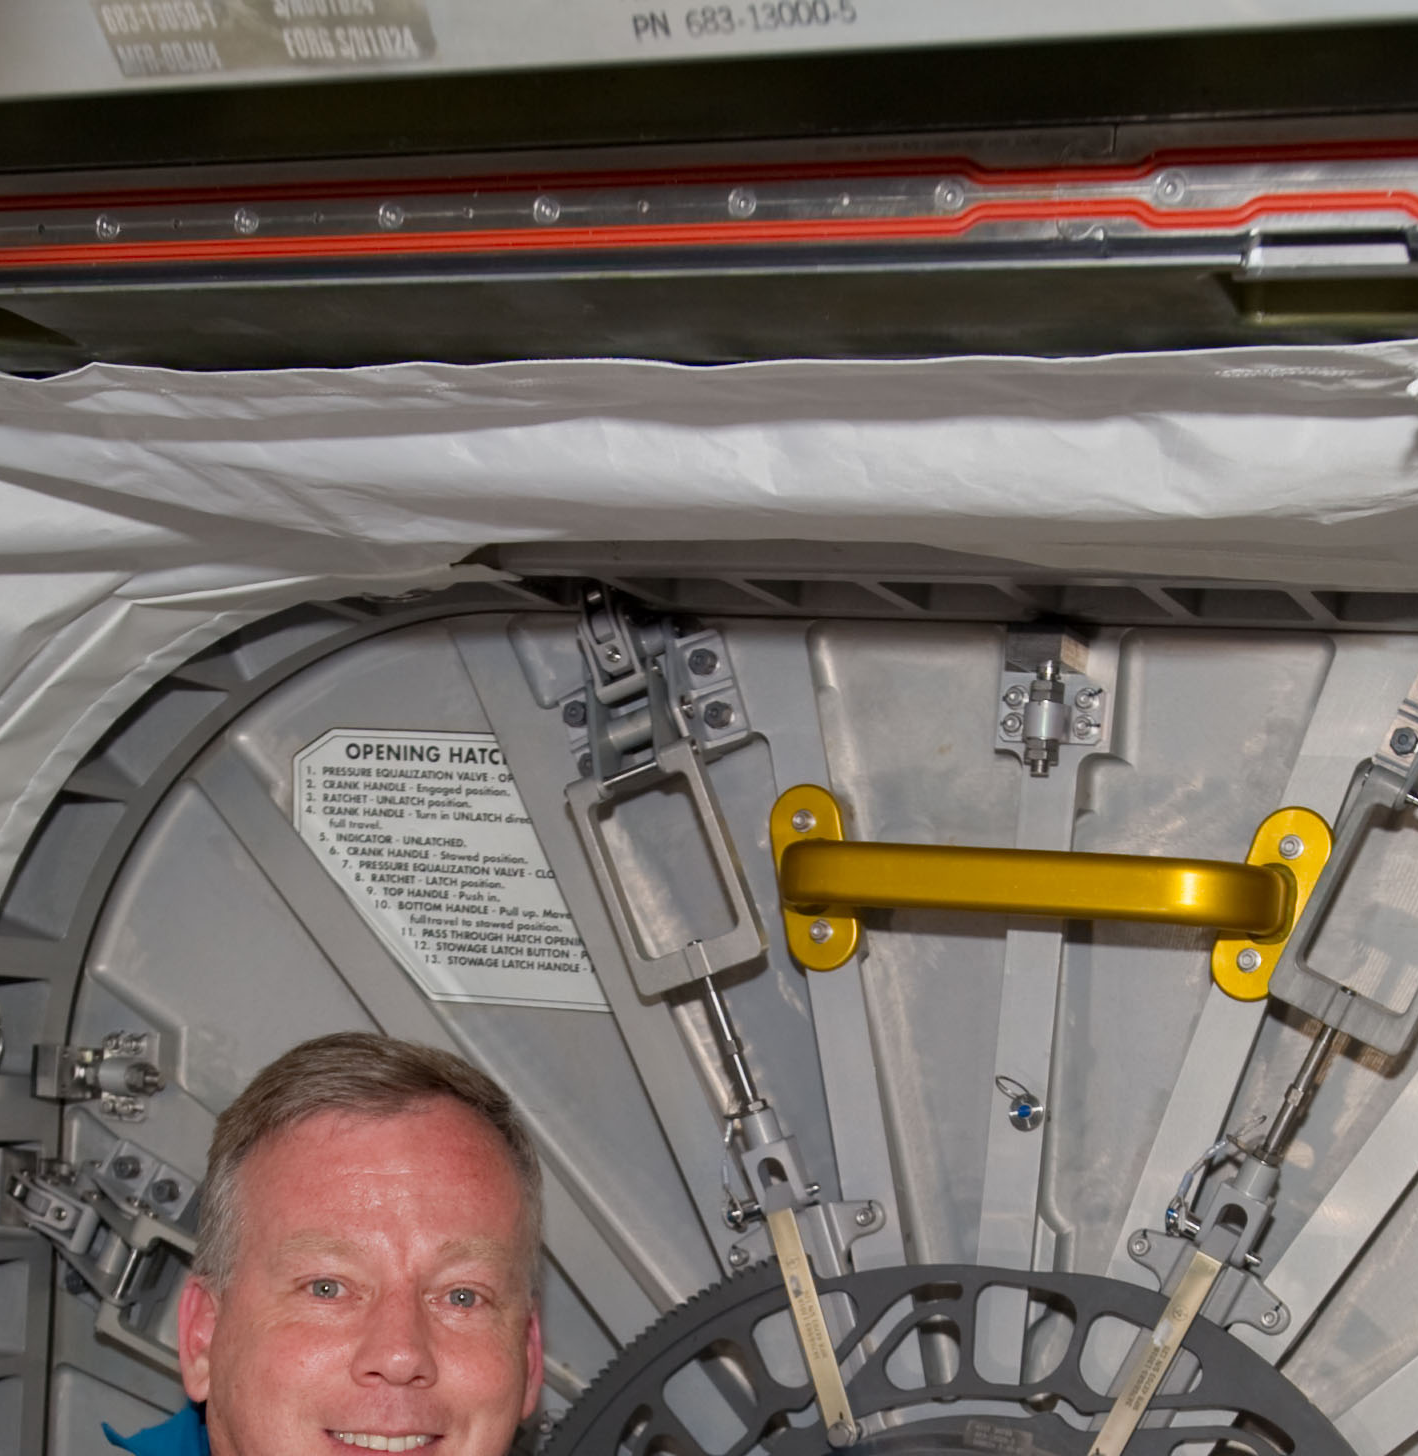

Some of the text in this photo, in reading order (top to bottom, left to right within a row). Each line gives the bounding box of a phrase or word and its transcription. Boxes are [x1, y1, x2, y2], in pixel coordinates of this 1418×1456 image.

[632, 11, 671, 41] PN
[345, 743, 441, 763] OPENING
[322, 766, 373, 778] PRESSURE
[376, 768, 453, 781] EQUALIZATION
[457, 771, 488, 782] VALVE
[322, 780, 359, 791] CRANK
[363, 782, 406, 793] HANDLE
[417, 783, 462, 797] Engaged
[465, 786, 511, 798] position.
[322, 793, 368, 804] RATCHET
[376, 795, 425, 807] UNLATCH
[427, 798, 472, 809] position.
[322, 806, 358, 817] CRANK
[363, 808, 405, 819] HANDLE
[415, 809, 438, 820] Turn
[453, 812, 502, 823] UNLATCH
[336, 833, 392, 844] INDICATOR
[403, 836, 467, 848] UNLATCHED.
[347, 846, 383, 857] CRANK
[387, 848, 429, 859] HANDLE
[440, 850, 479, 862] Stowed
[483, 854, 529, 865] position.
[359, 860, 409, 872] PRESSURE
[413, 862, 490, 875] EQUALIZATION
[494, 867, 525, 878] VALVE
[371, 873, 415, 884] RATCHET
[426, 876, 458, 887] LATCH
[461, 879, 506, 890] position.
[383, 886, 404, 897] TOP
[407, 888, 449, 900] HANDLE
[459, 890, 485, 901] Push
[398, 901, 442, 912] BOTTOM
[446, 903, 489, 915] HANDLE
[499, 906, 519, 917] Pull
[522, 910, 539, 920] up.
[423, 928, 447, 939] PASS
[451, 930, 503, 942] THROUGH
[506, 933, 541, 945] HATCH
[436, 942, 488, 954] STOWAGE
[491, 946, 523, 957] LATCH
[527, 947, 570, 959] BUTTON
[447, 955, 499, 968] STOWAGE
[501, 959, 535, 970] LATCH
[537, 962, 580, 974] HANDLE
